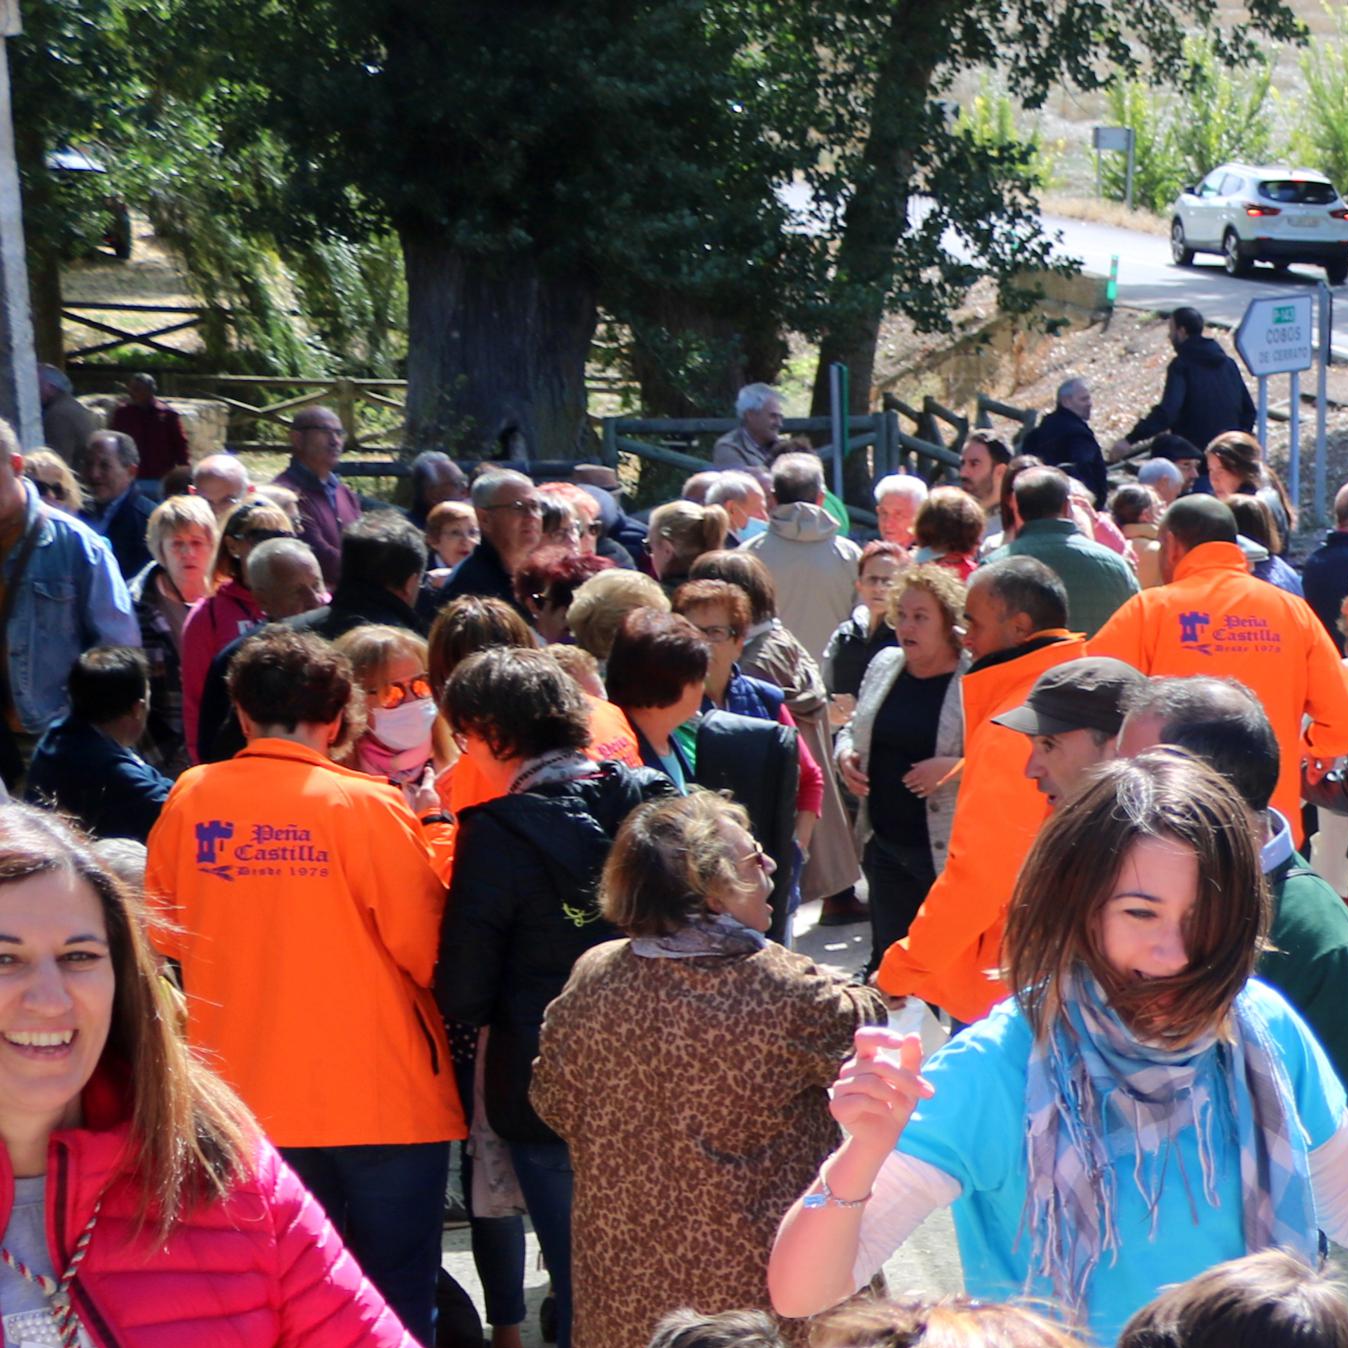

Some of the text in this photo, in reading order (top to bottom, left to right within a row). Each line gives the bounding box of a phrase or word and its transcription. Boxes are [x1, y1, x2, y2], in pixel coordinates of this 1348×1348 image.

[1265, 326, 1301, 344] COBOS
[1258, 350, 1269, 363] DE
[1223, 614, 1268, 629] Peña
[1212, 628, 1281, 643] Castilla
[250, 823, 311, 844] Peña
[234, 843, 329, 863] Castilla
[237, 866, 330, 878] Desde 1978
